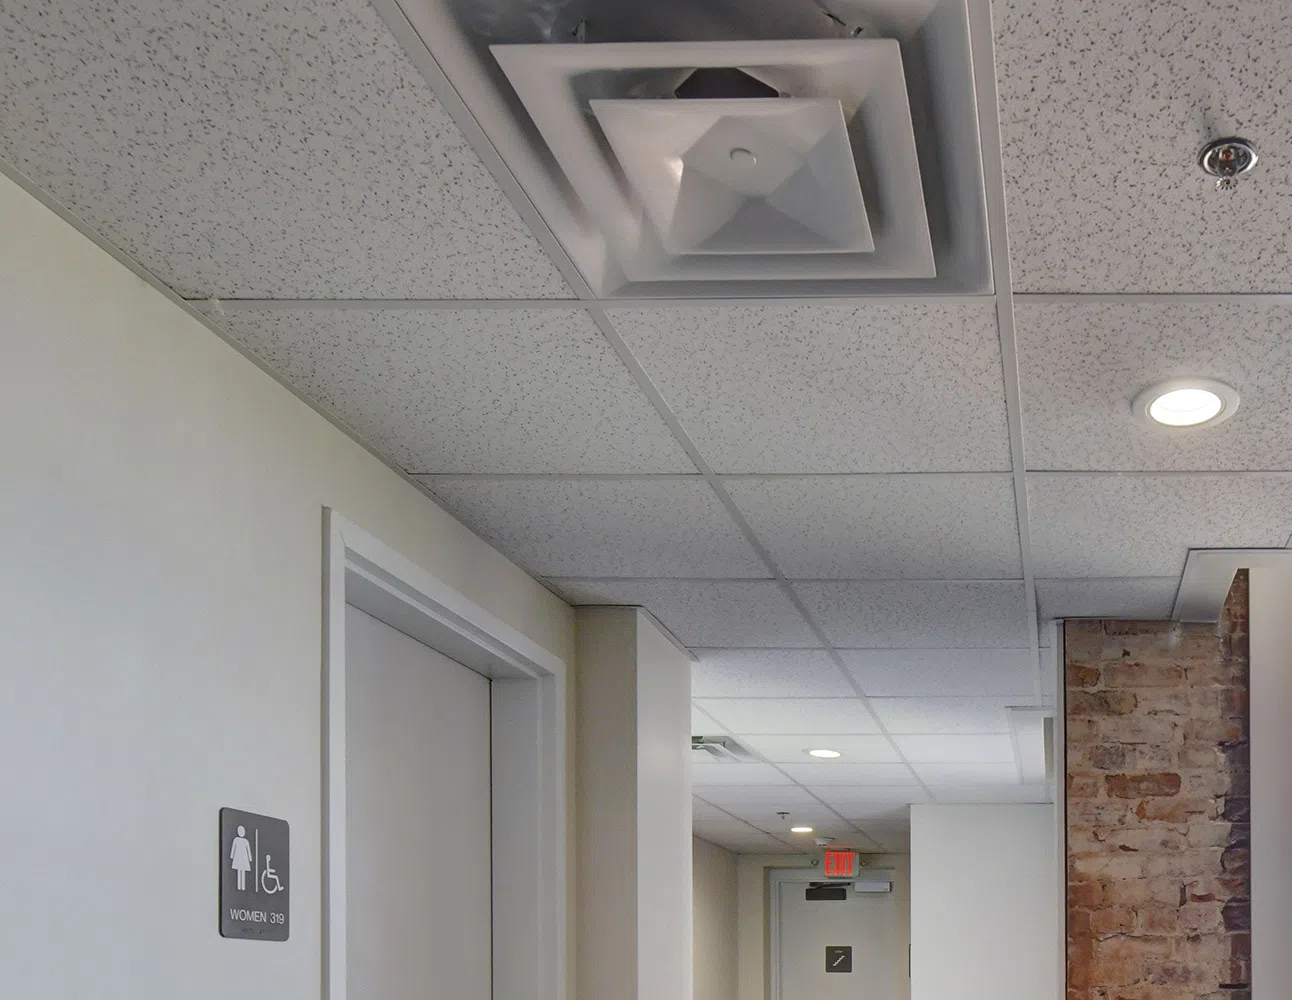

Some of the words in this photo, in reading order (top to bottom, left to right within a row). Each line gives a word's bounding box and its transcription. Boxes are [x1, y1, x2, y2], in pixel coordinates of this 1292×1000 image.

[825, 851, 855, 876] EXIT
[229, 908, 267, 923] WOMEN
[270, 912, 285, 925] 319
